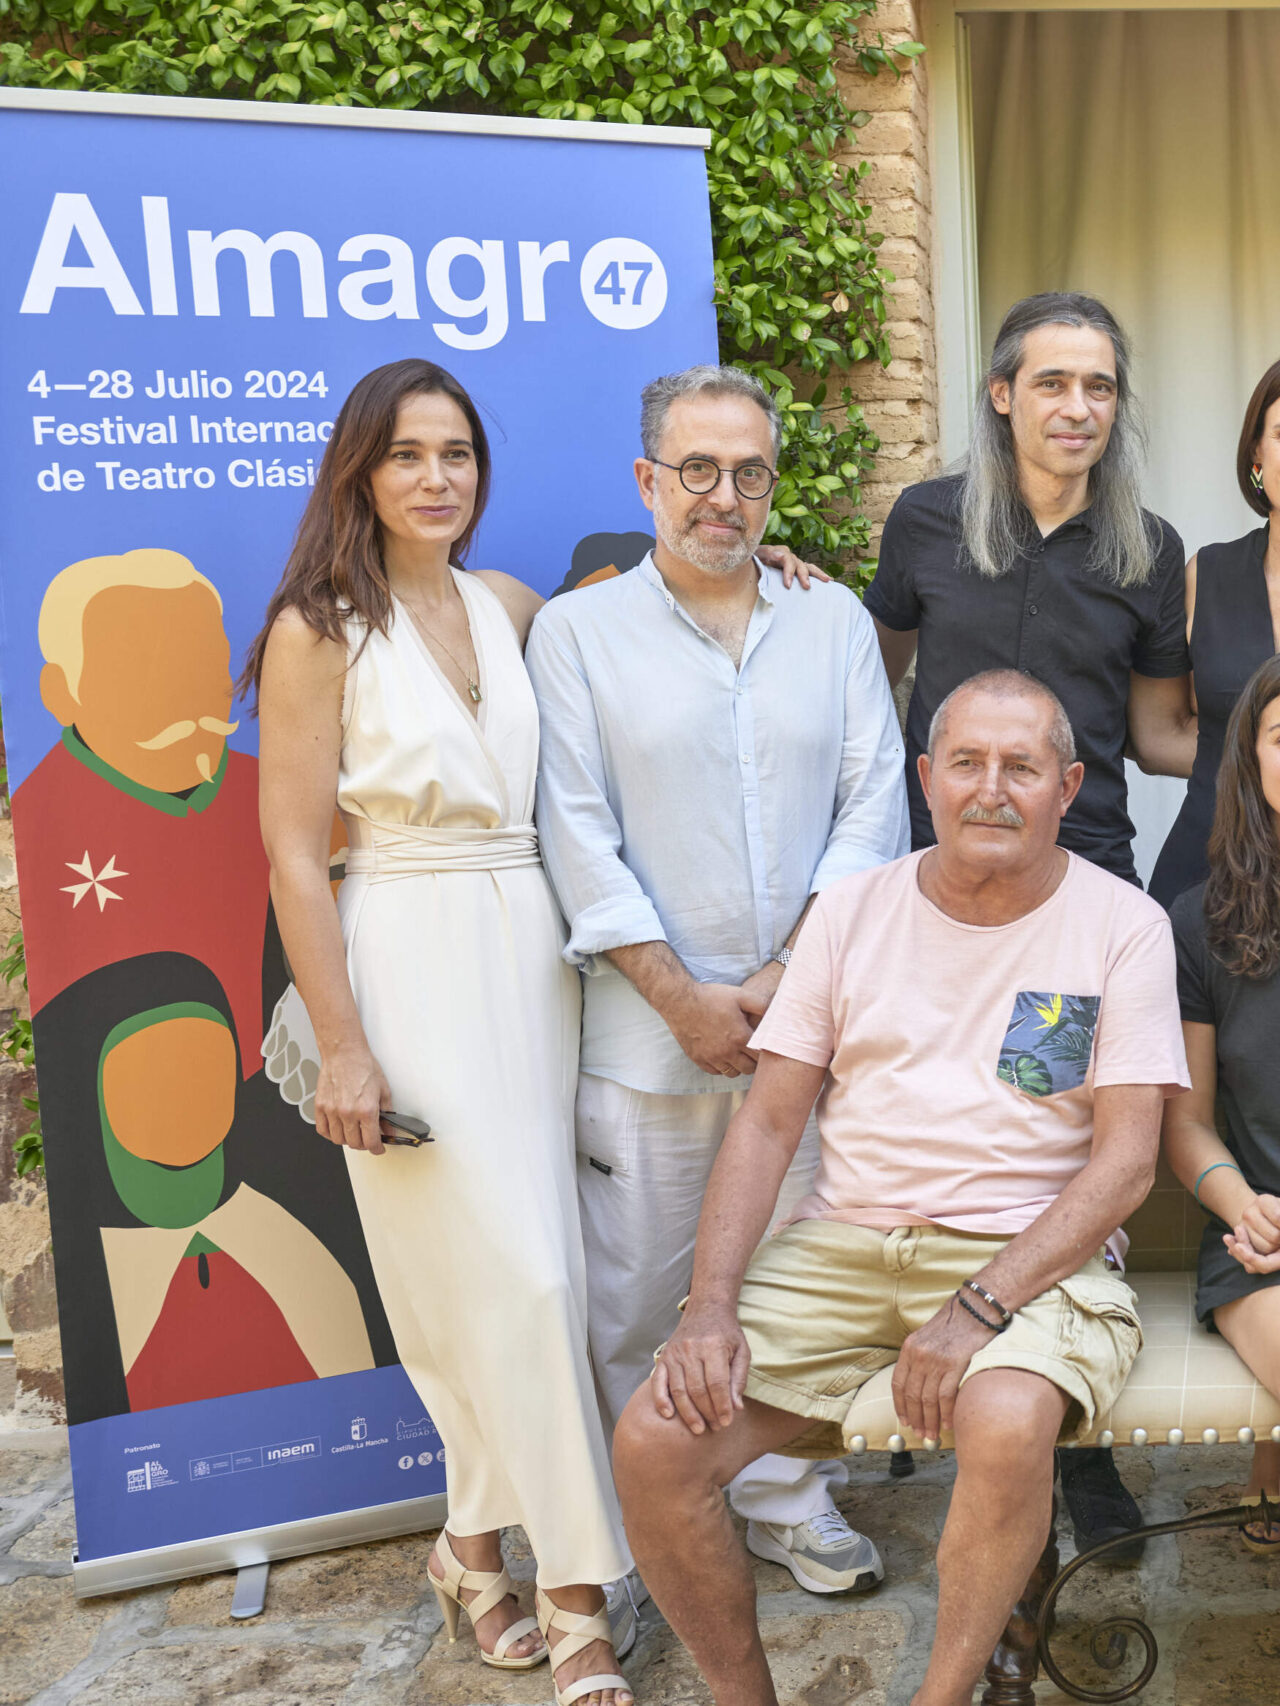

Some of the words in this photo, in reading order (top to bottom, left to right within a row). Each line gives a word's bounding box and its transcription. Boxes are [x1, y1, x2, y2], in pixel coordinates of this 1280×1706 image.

[593, 261, 654, 306] 47
[144, 369, 234, 399] Julio
[243, 369, 329, 399] 2024
[32, 415, 178, 446] Festival
[37, 462, 86, 492] de
[95, 461, 216, 491] Teatro
[227, 458, 320, 488] Clási
[124, 1443, 161, 1454] Patronato
[267, 1442, 315, 1461] inaem
